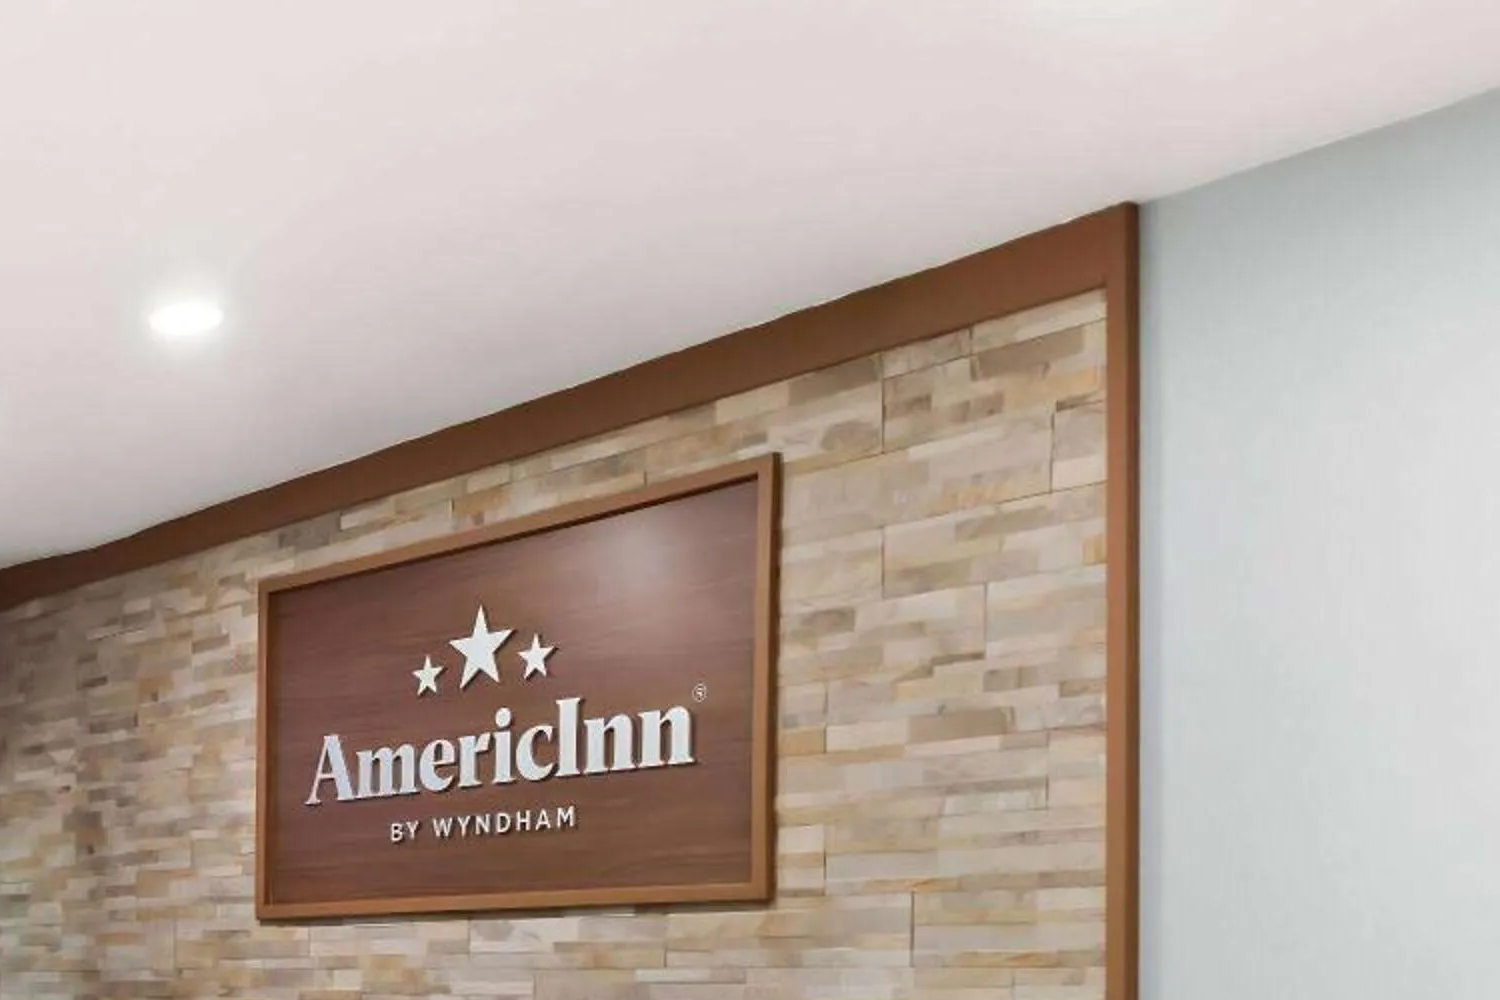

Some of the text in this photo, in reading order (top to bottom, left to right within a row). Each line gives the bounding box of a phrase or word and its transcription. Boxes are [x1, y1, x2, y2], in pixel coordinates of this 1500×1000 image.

[305, 697, 695, 806] AmericInn
[390, 806, 577, 843] BY WYNDHAM
